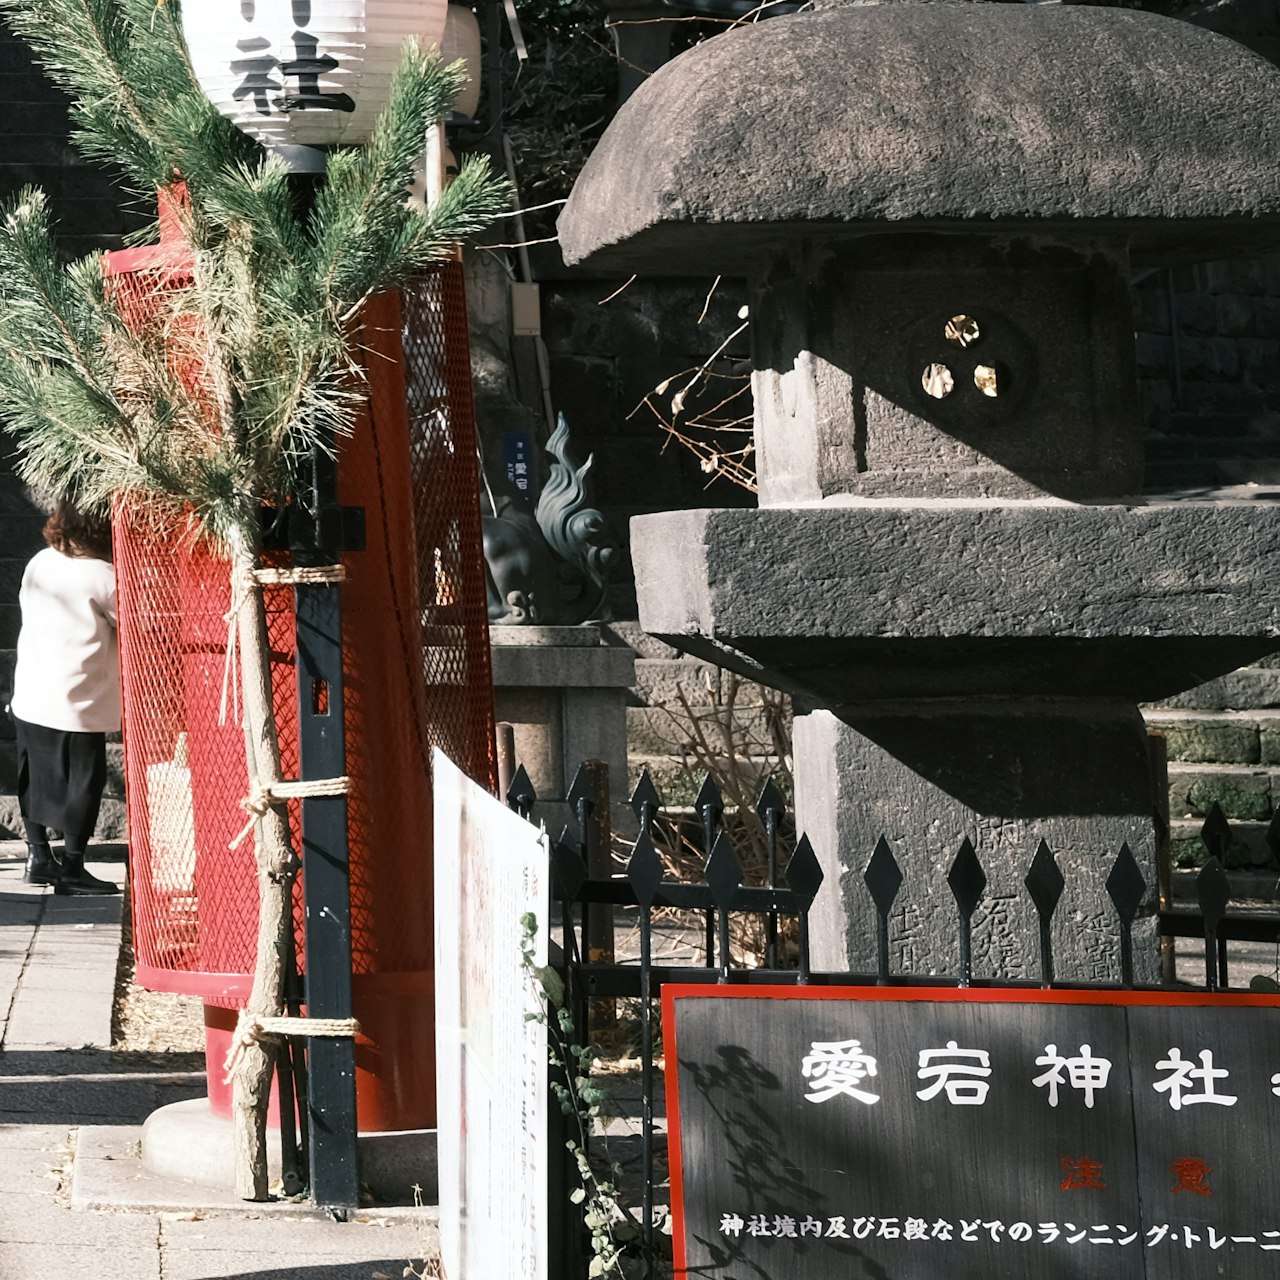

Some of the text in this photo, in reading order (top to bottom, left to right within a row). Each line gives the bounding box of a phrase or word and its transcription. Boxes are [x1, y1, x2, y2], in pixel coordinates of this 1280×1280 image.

[801, 1039, 1280, 1111] 愛宕神社
[1059, 1154, 1213, 1197] 注意
